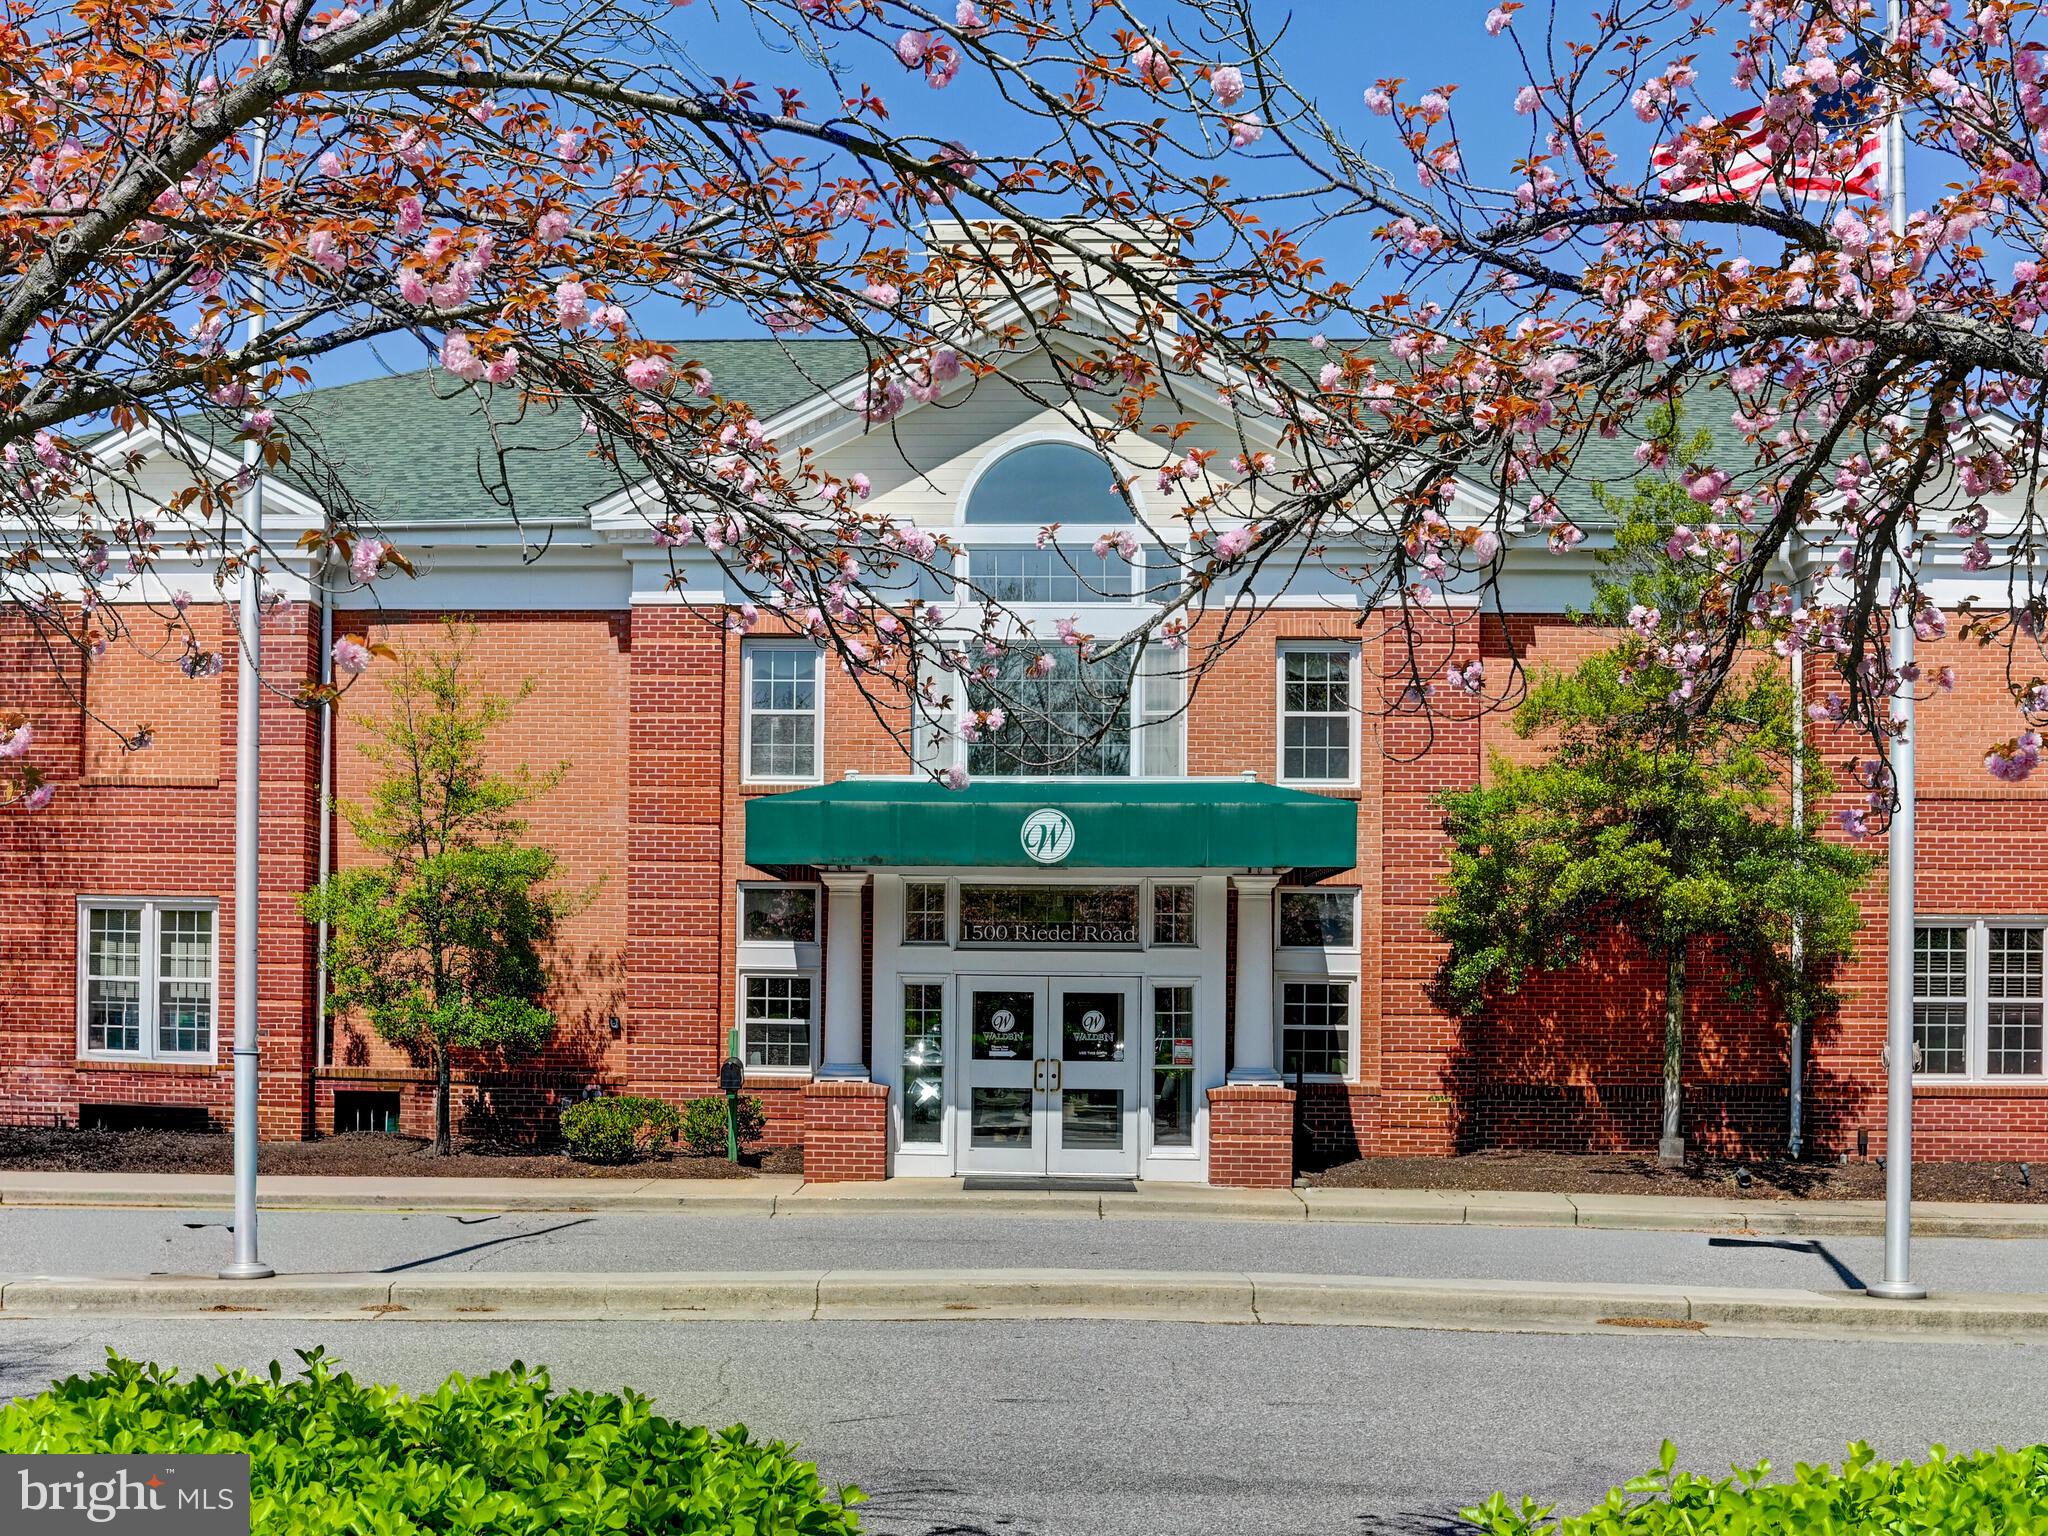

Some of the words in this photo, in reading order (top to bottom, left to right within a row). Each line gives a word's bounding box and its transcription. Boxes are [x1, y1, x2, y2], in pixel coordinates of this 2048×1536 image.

[1023, 816, 1067, 857] W
[963, 924, 1008, 940] 1500
[1014, 924, 1077, 941] Riedel
[1084, 925, 1136, 941] Road
[982, 1031, 1024, 1042] WALDEN
[1072, 1031, 1115, 1042] WALDEN
